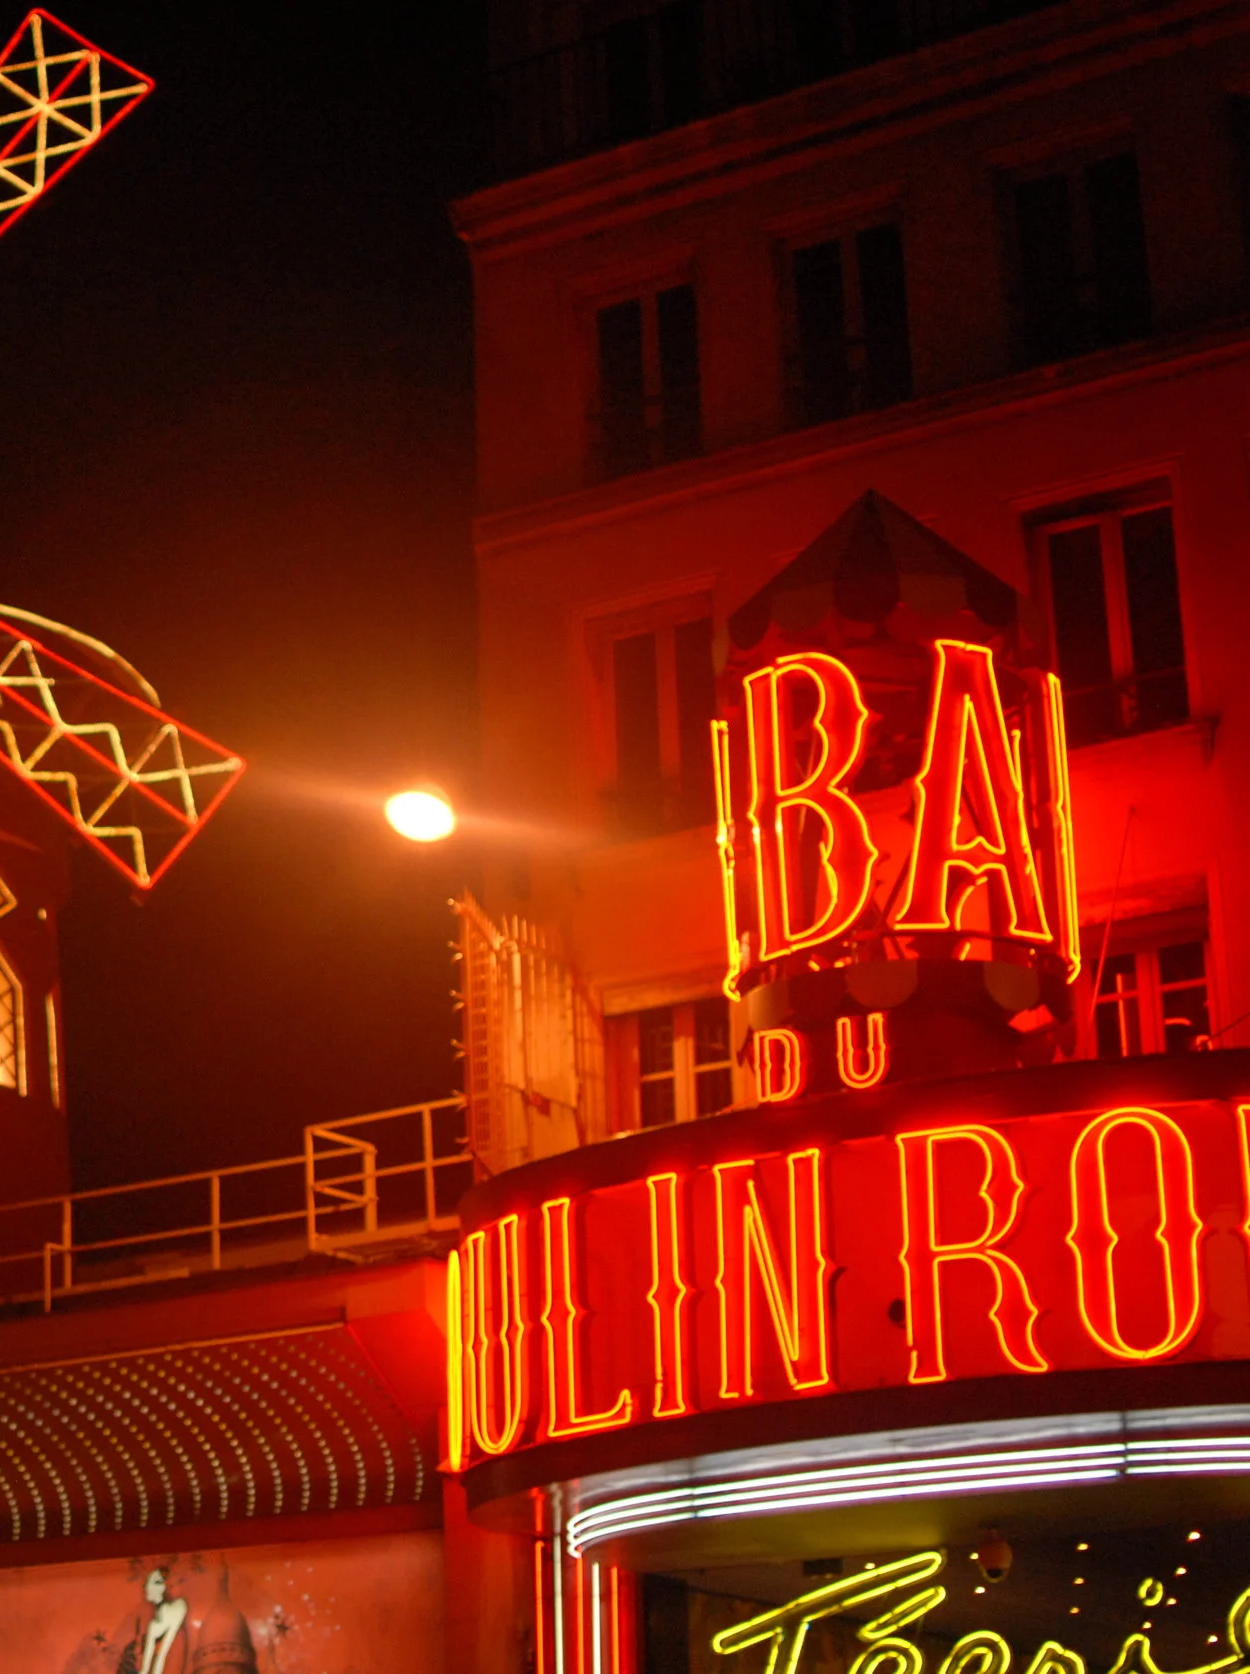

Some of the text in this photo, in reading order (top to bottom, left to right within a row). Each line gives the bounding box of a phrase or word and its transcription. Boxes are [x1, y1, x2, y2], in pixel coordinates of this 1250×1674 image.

[742, 638, 1081, 985] BA
[753, 1012, 886, 1103] DU
[447, 1103, 1250, 1473] ULIN RO
